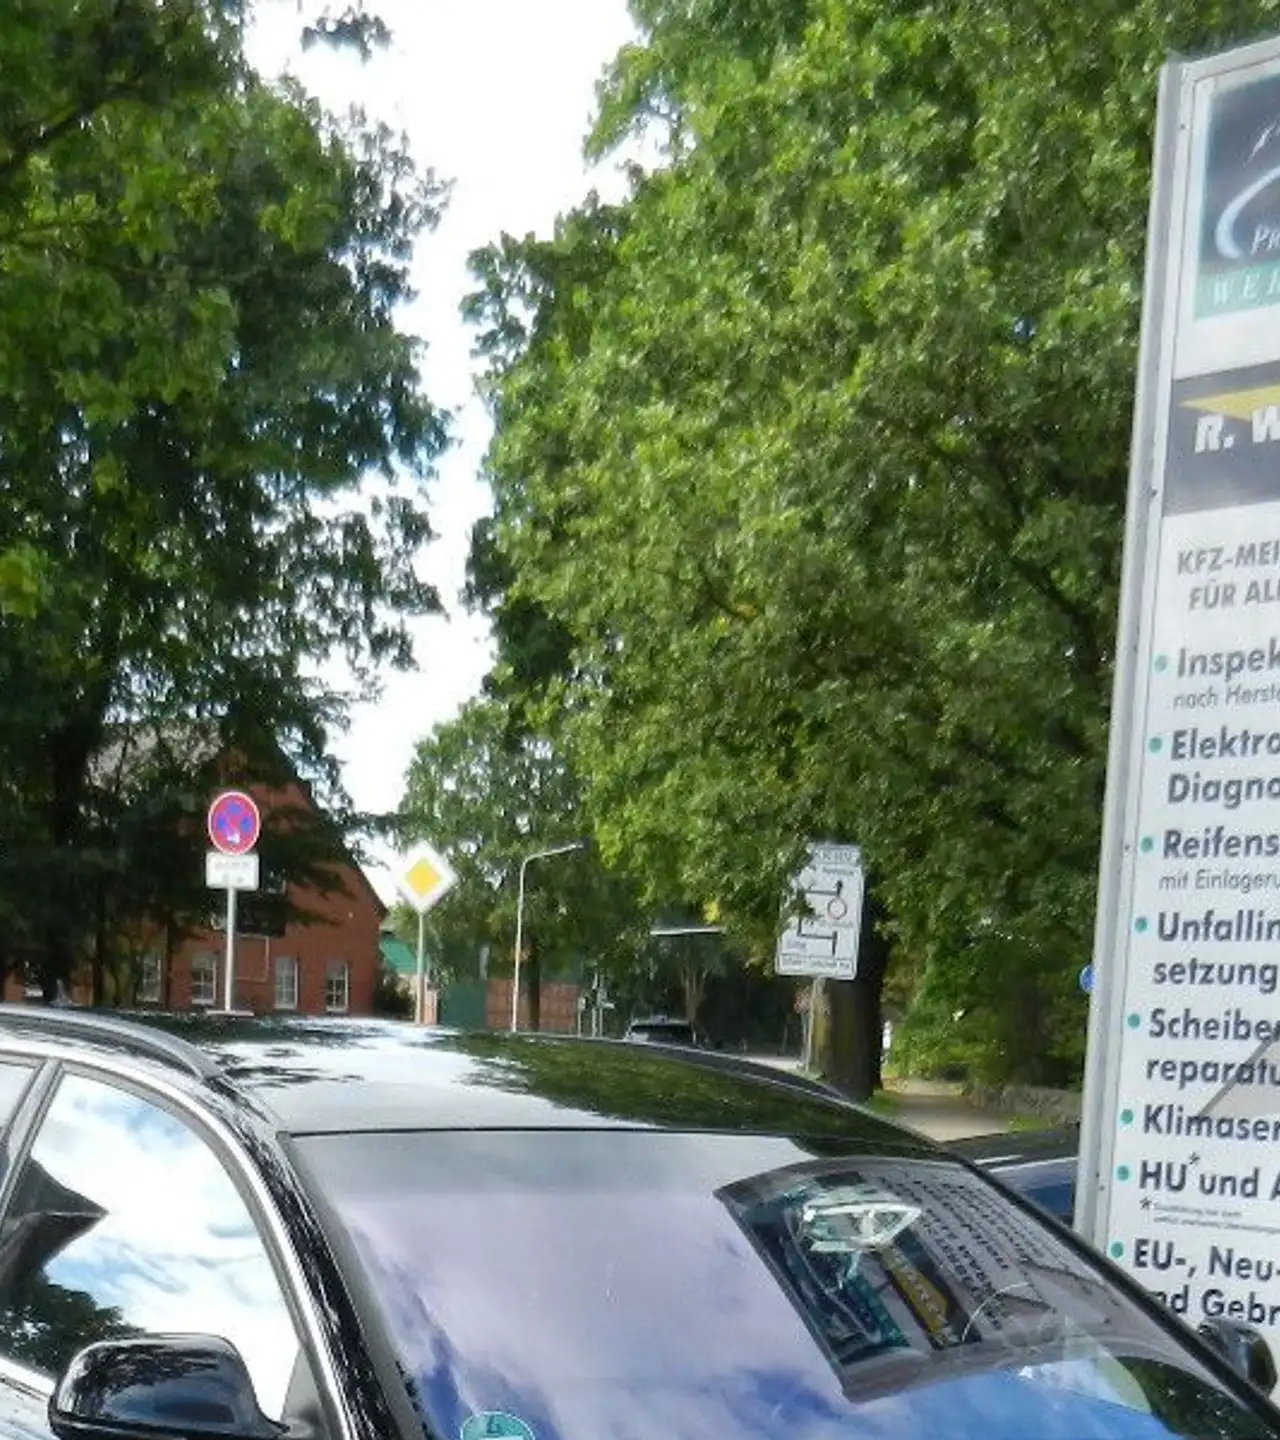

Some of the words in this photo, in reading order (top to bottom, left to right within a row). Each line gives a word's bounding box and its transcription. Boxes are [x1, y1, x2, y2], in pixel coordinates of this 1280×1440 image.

[1194, 415, 1235, 454] R.
[1188, 577, 1235, 610] FÜR
[1173, 684, 1218, 709] nach
[1159, 871, 1189, 890] mit
[1153, 959, 1278, 993] setzung
[1199, 1167, 1259, 1200] und
[1133, 1238, 1197, 1279] EU-,
[1149, 1285, 1190, 1314] nd
